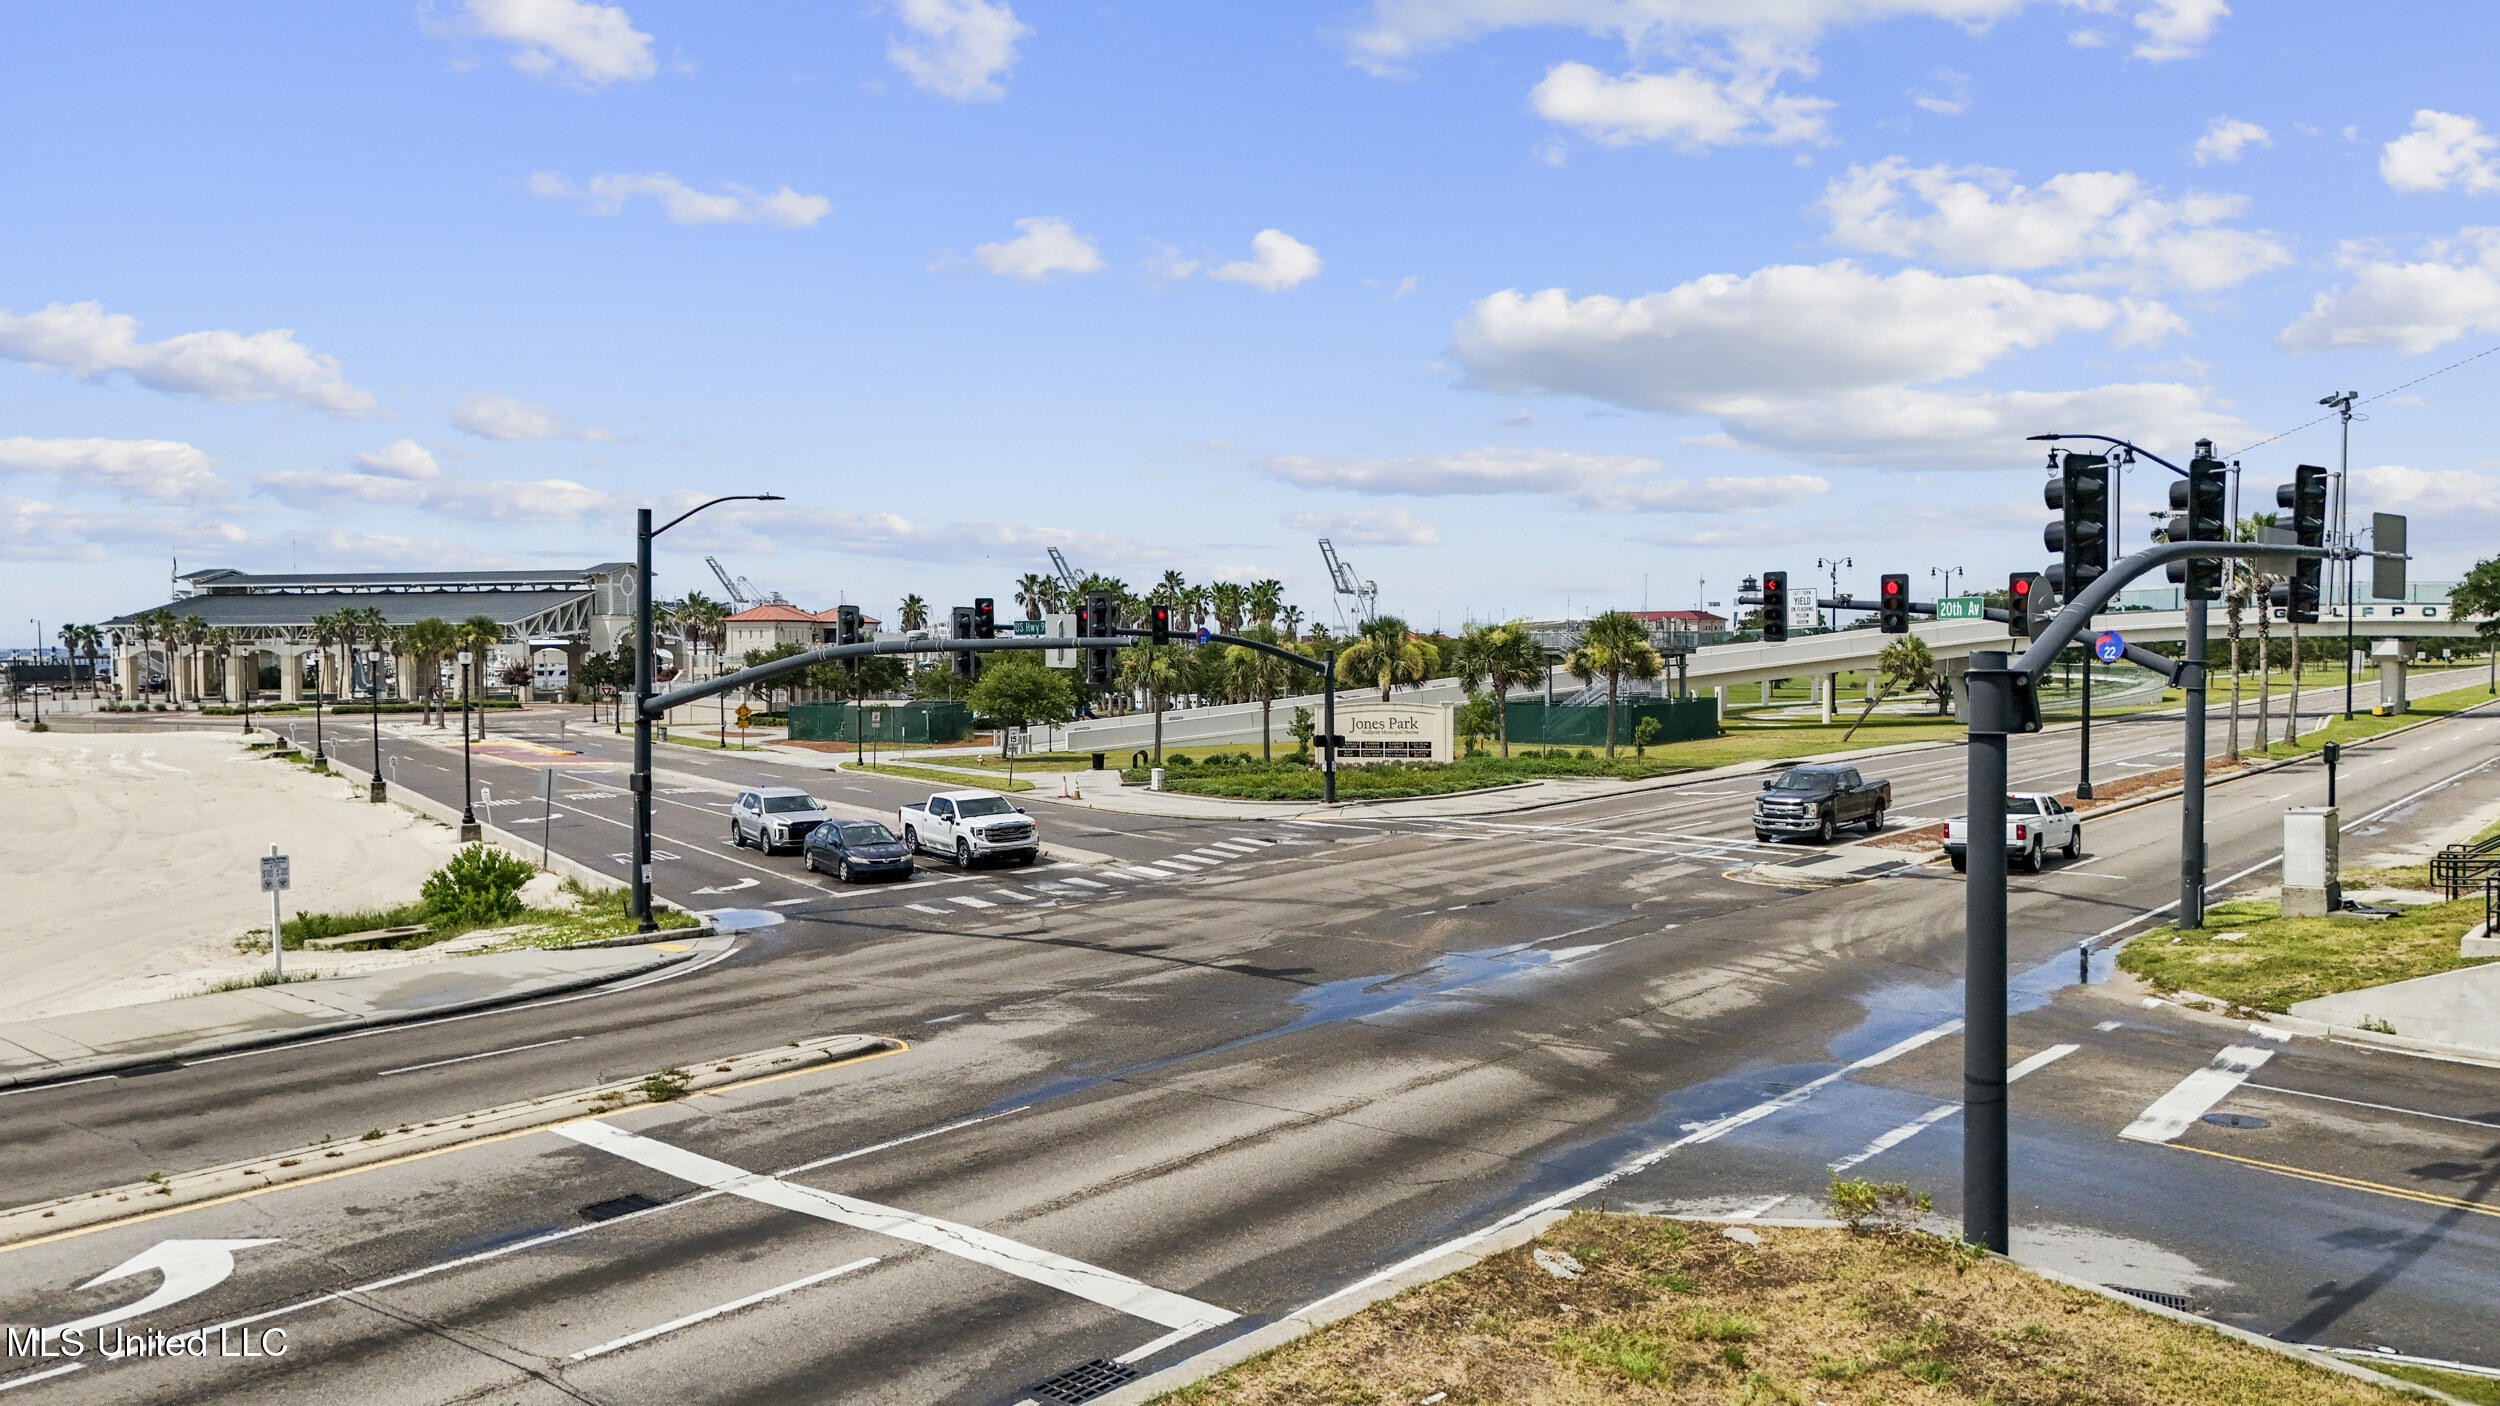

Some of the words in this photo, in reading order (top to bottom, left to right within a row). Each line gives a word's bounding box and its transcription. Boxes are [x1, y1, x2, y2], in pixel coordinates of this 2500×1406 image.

[1794, 597, 1811, 605] YIELD
[1940, 601, 1962, 616] 20th
[1968, 601, 1979, 616] Av
[1015, 622, 1023, 632] US
[1026, 622, 1039, 634] Hwy
[1040, 622, 1045, 631] 9
[1200, 636, 1206, 644] 22
[2104, 646, 2115, 659] 22
[1349, 717, 1385, 733] Jones
[1389, 716, 1418, 729] Park
